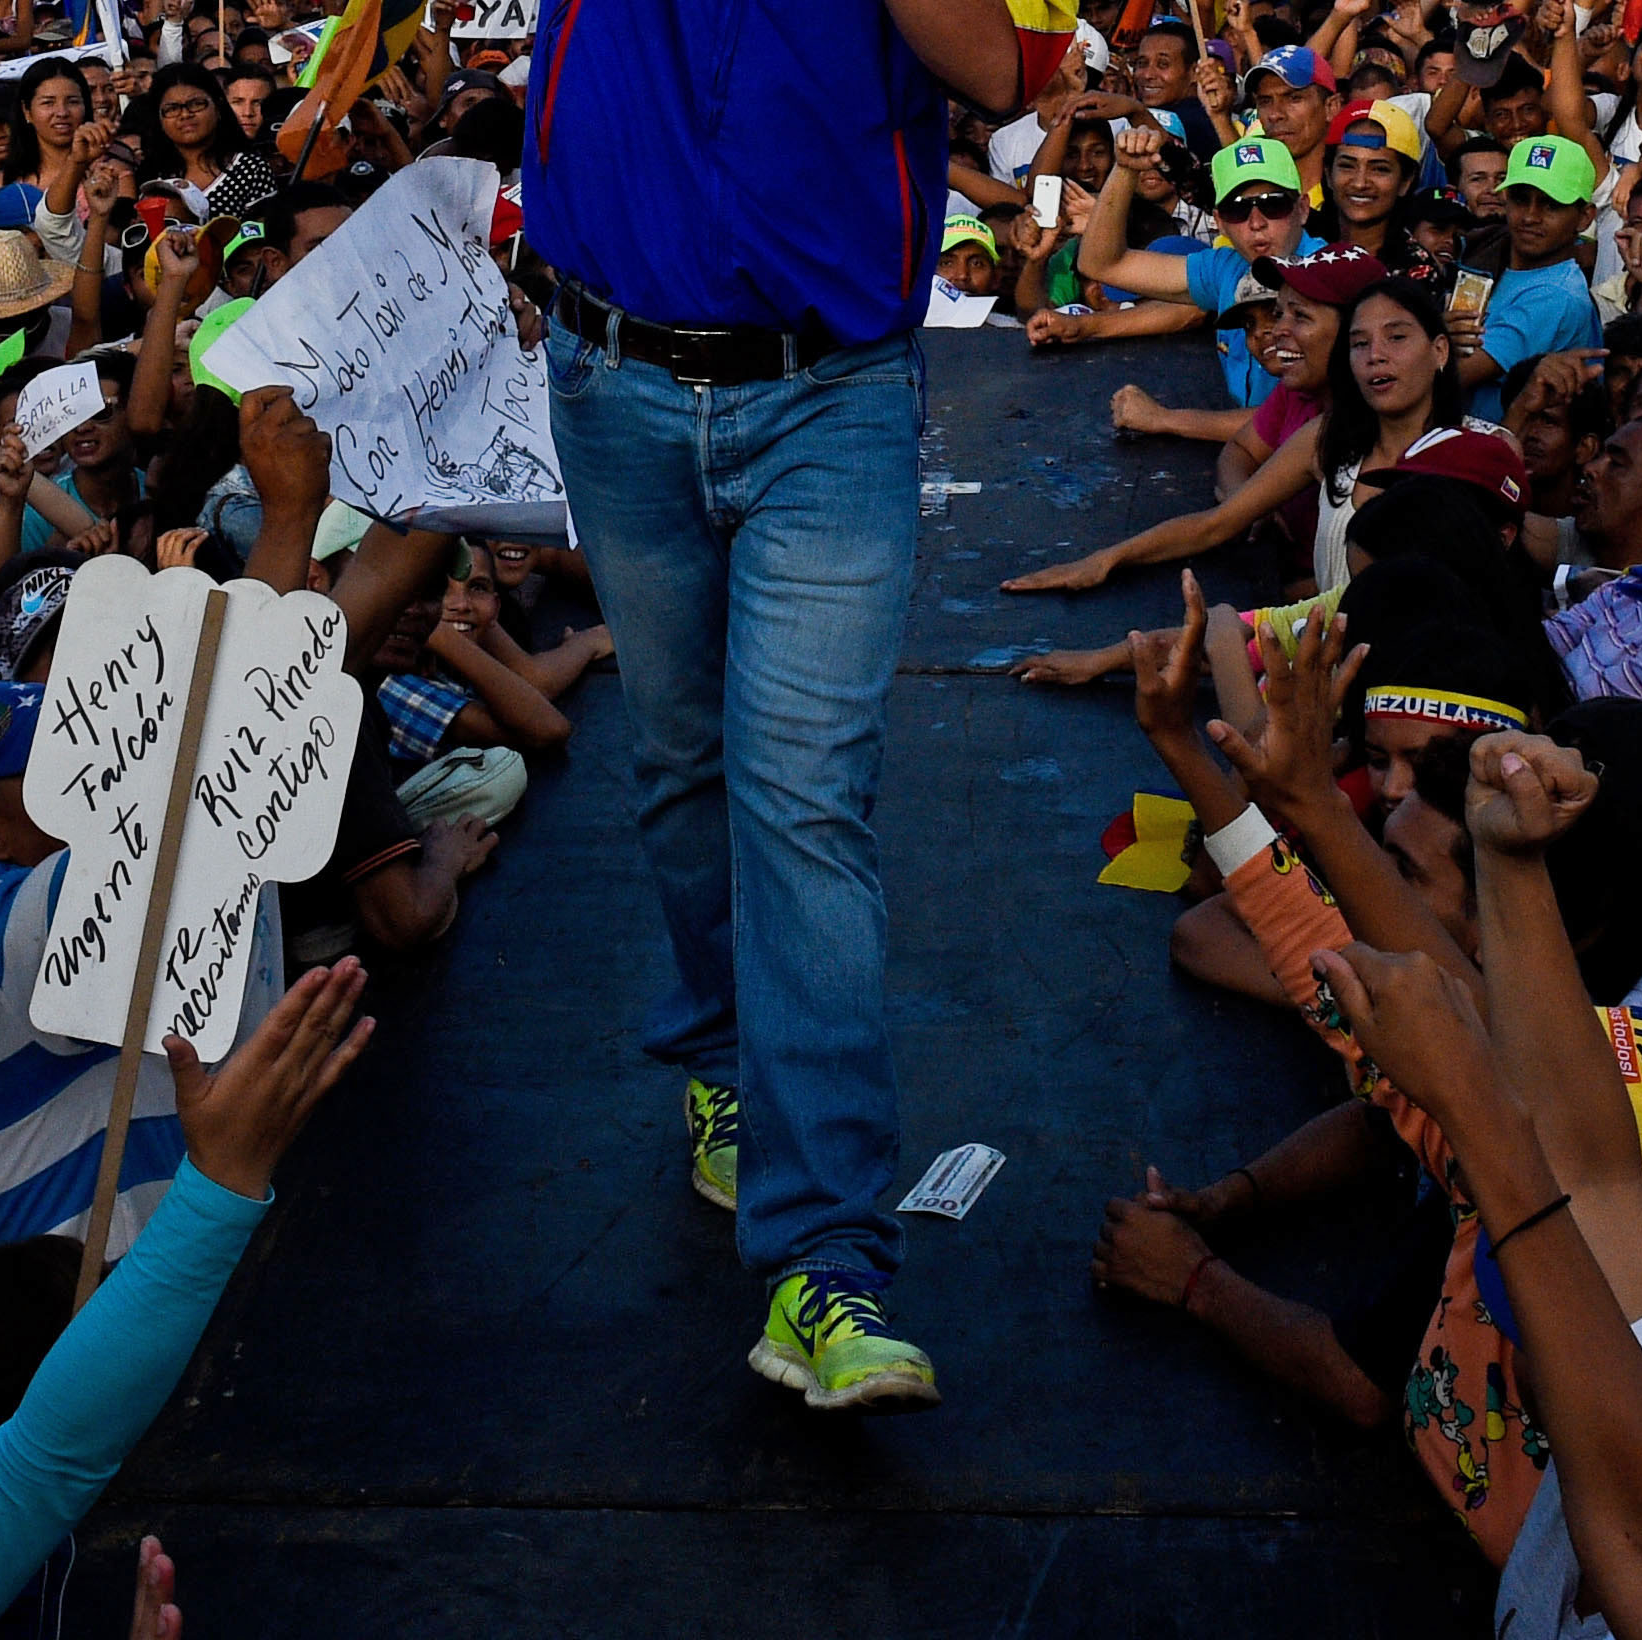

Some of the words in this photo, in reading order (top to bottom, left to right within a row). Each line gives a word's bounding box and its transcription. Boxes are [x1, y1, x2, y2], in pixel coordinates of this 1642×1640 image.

[1239, 153, 1261, 164] VA
[1531, 156, 1547, 167] VA
[275, 337, 370, 409] Moto
[336, 272, 406, 354] Taxi
[394, 249, 433, 302] de
[53, 614, 165, 746] Henry
[244, 610, 344, 721] Pineda
[1365, 693, 1469, 724] NEZUELA
[61, 692, 173, 811] Falcón
[1612, 1020, 1638, 1078] todos!
[912, 1196, 959, 1211] 100
